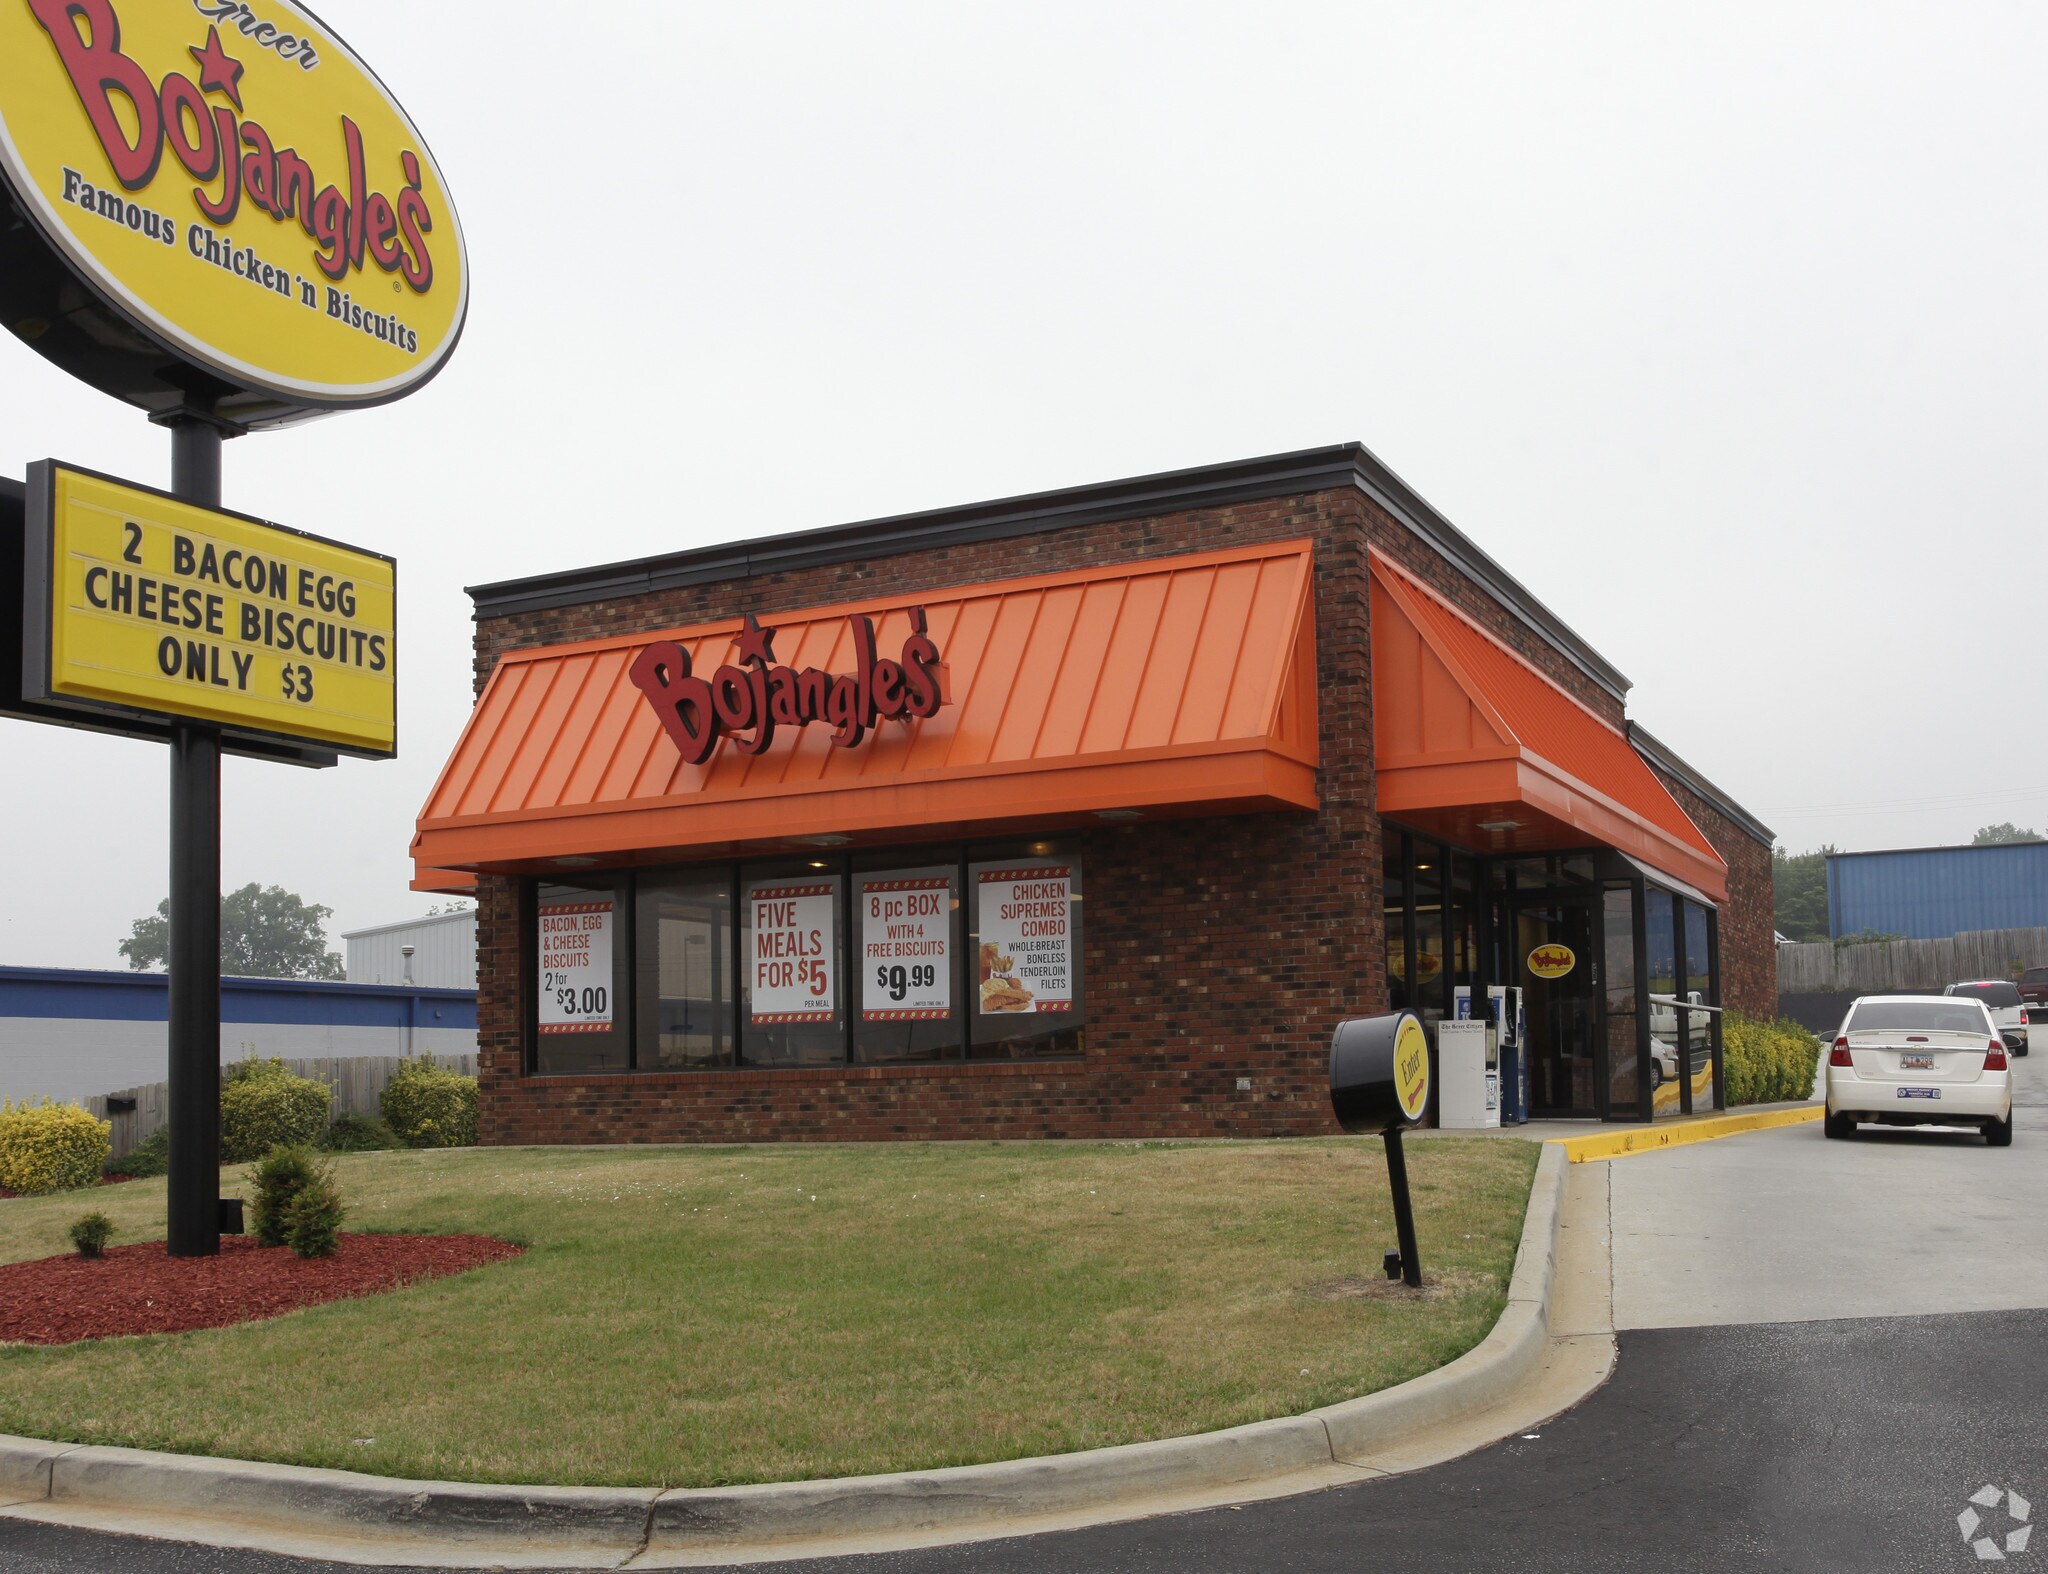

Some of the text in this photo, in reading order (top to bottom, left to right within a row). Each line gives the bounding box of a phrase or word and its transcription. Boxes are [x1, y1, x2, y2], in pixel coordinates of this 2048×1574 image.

[28, 0, 433, 293] Bojangle's
[63, 167, 175, 245] Famous
[188, 224, 291, 296] Chicken
[327, 286, 417, 354] Biscuits
[123, 522, 356, 618] 2 BACON EGG
[85, 566, 386, 671] CHEESE BISCUITS
[158, 636, 314, 702] ONLY $3
[629, 606, 941, 765] Bojangle's
[1013, 883, 1065, 900] CHICKEN
[758, 901, 797, 929] FIVE
[871, 894, 940, 922] 8 pc BOX
[1001, 901, 1066, 919] SUPREMES
[543, 915, 603, 933] BACON, EGG
[887, 924, 924, 939] WITH 4
[1022, 919, 1065, 937] COMBO
[544, 934, 590, 950] & CHEESE
[758, 929, 822, 958] MEALS
[867, 941, 945, 958] FREE BISCUITS
[1009, 940, 1065, 952] WHOLE-BREAST
[543, 952, 589, 969] BISCUITS
[1027, 953, 1066, 964] BONELESS
[758, 958, 827, 996] FOR $5
[1020, 966, 1066, 977] TENDERLOIN
[545, 972, 568, 991] 2 for
[877, 964, 935, 1001] $9.99
[1041, 979, 1066, 989] FILETS
[557, 986, 607, 1015] $3.00
[804, 999, 830, 1008] PER MEAL
[1401, 1048, 1421, 1087] Enter
